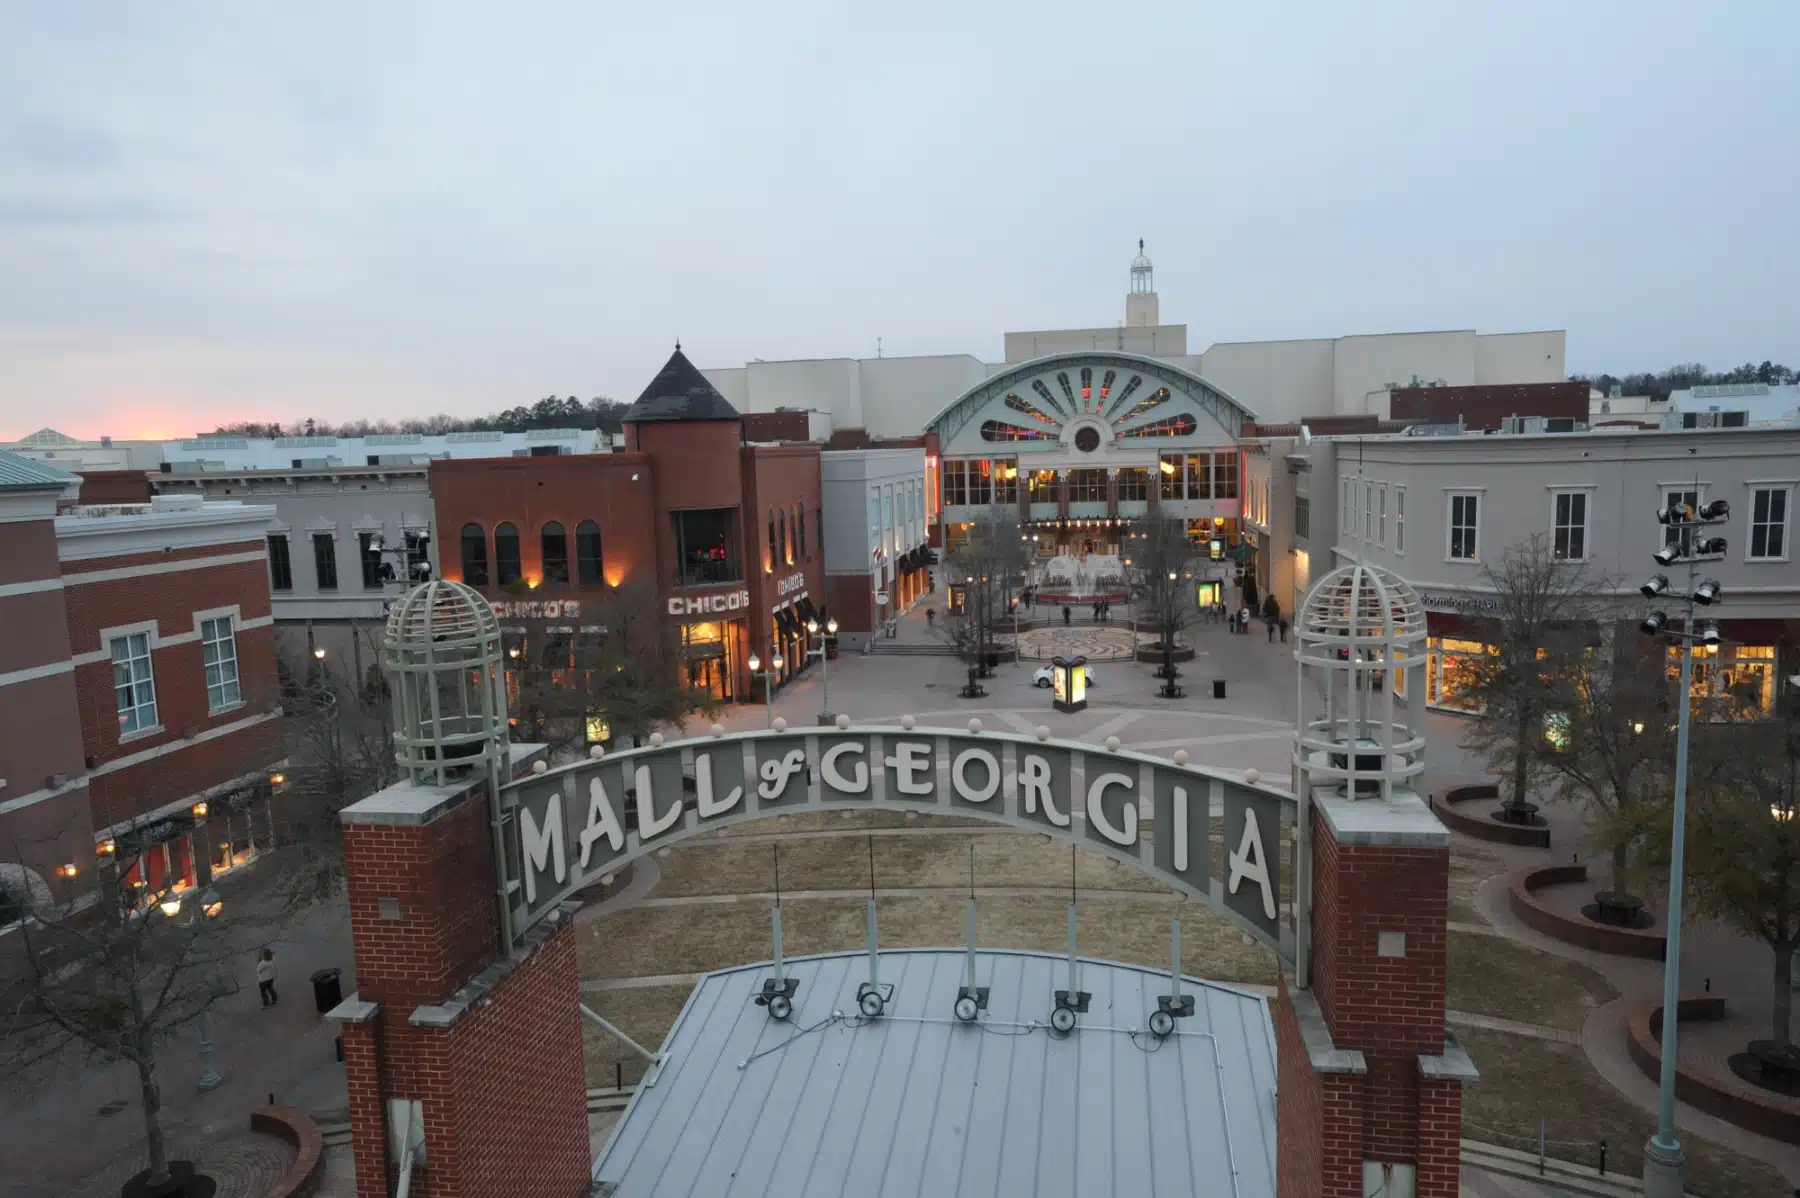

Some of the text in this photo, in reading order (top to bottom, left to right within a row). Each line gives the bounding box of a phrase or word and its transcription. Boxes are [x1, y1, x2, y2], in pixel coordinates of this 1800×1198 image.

[667, 589, 749, 615] CHICO'S
[519, 741, 1277, 920] MALL of GEORGIA
